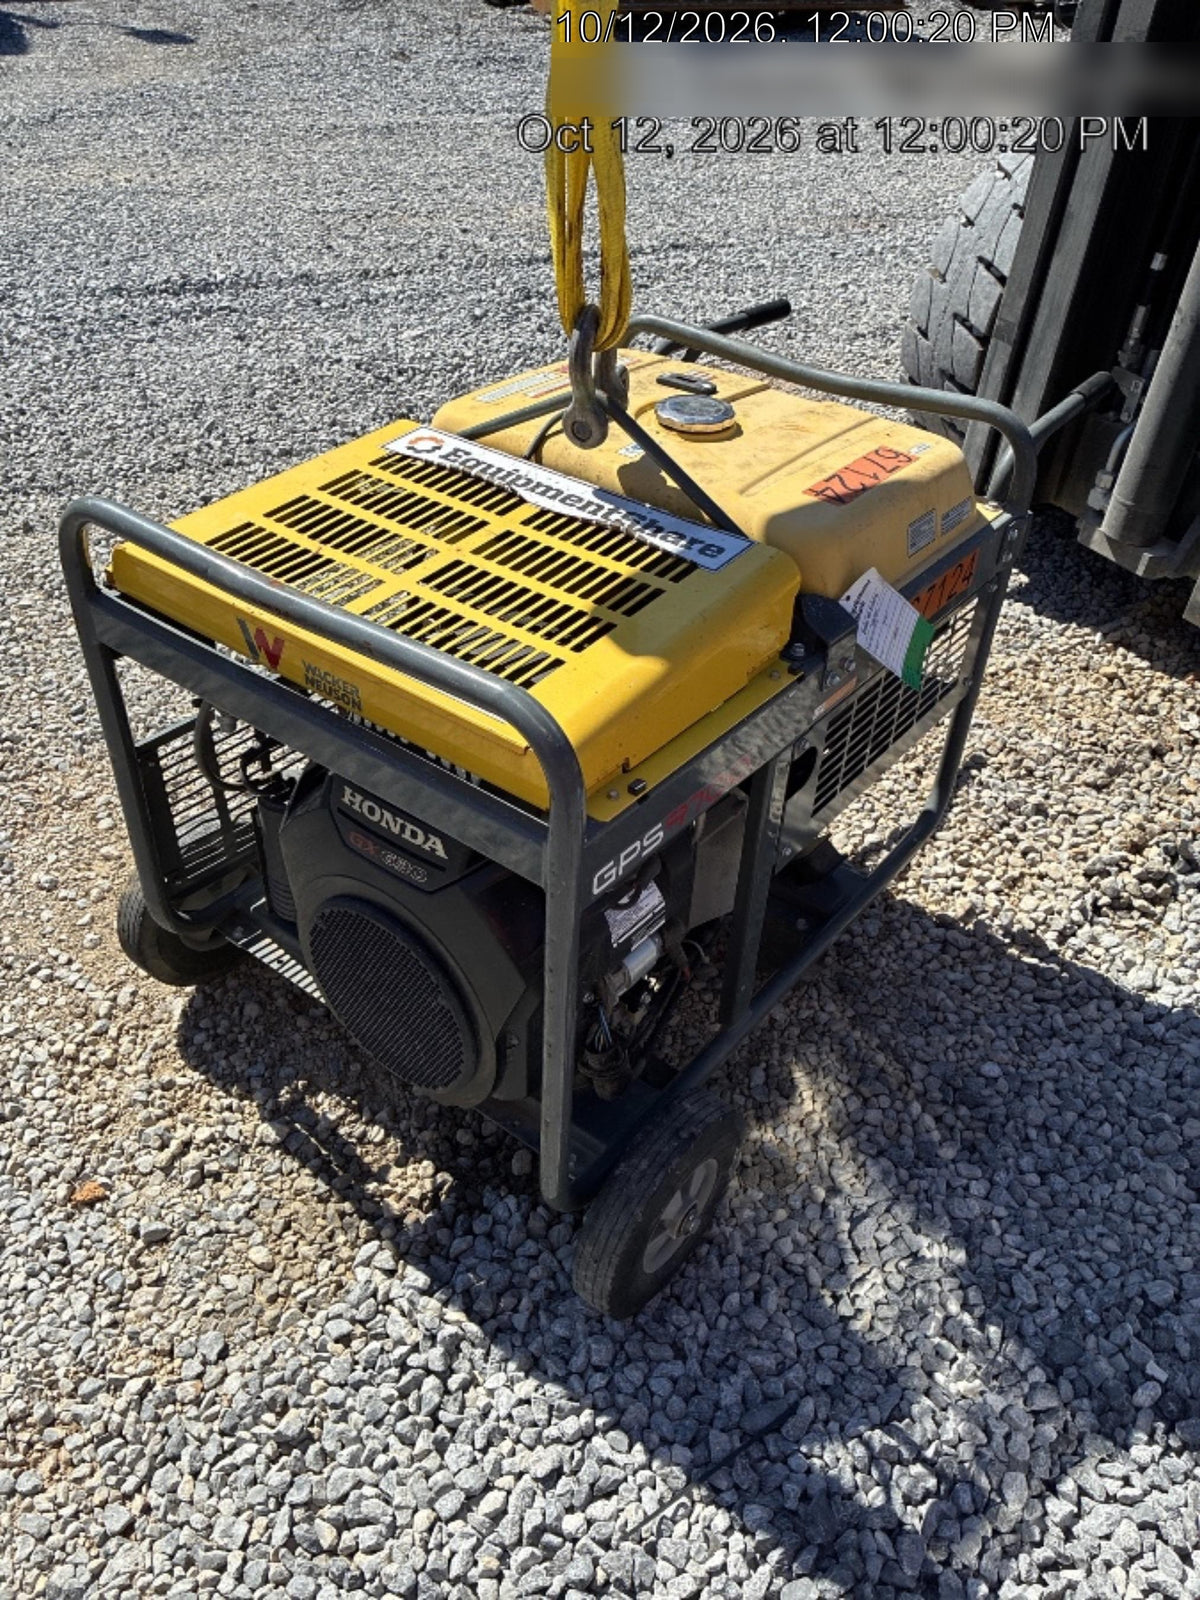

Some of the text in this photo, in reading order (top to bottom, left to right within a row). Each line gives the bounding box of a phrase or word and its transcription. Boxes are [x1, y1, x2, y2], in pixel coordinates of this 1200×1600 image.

[908, 552, 979, 616] 7124
[302, 659, 361, 700] WACKER
[305, 672, 362, 711] NEUSON
[341, 785, 449, 860] HONDA
